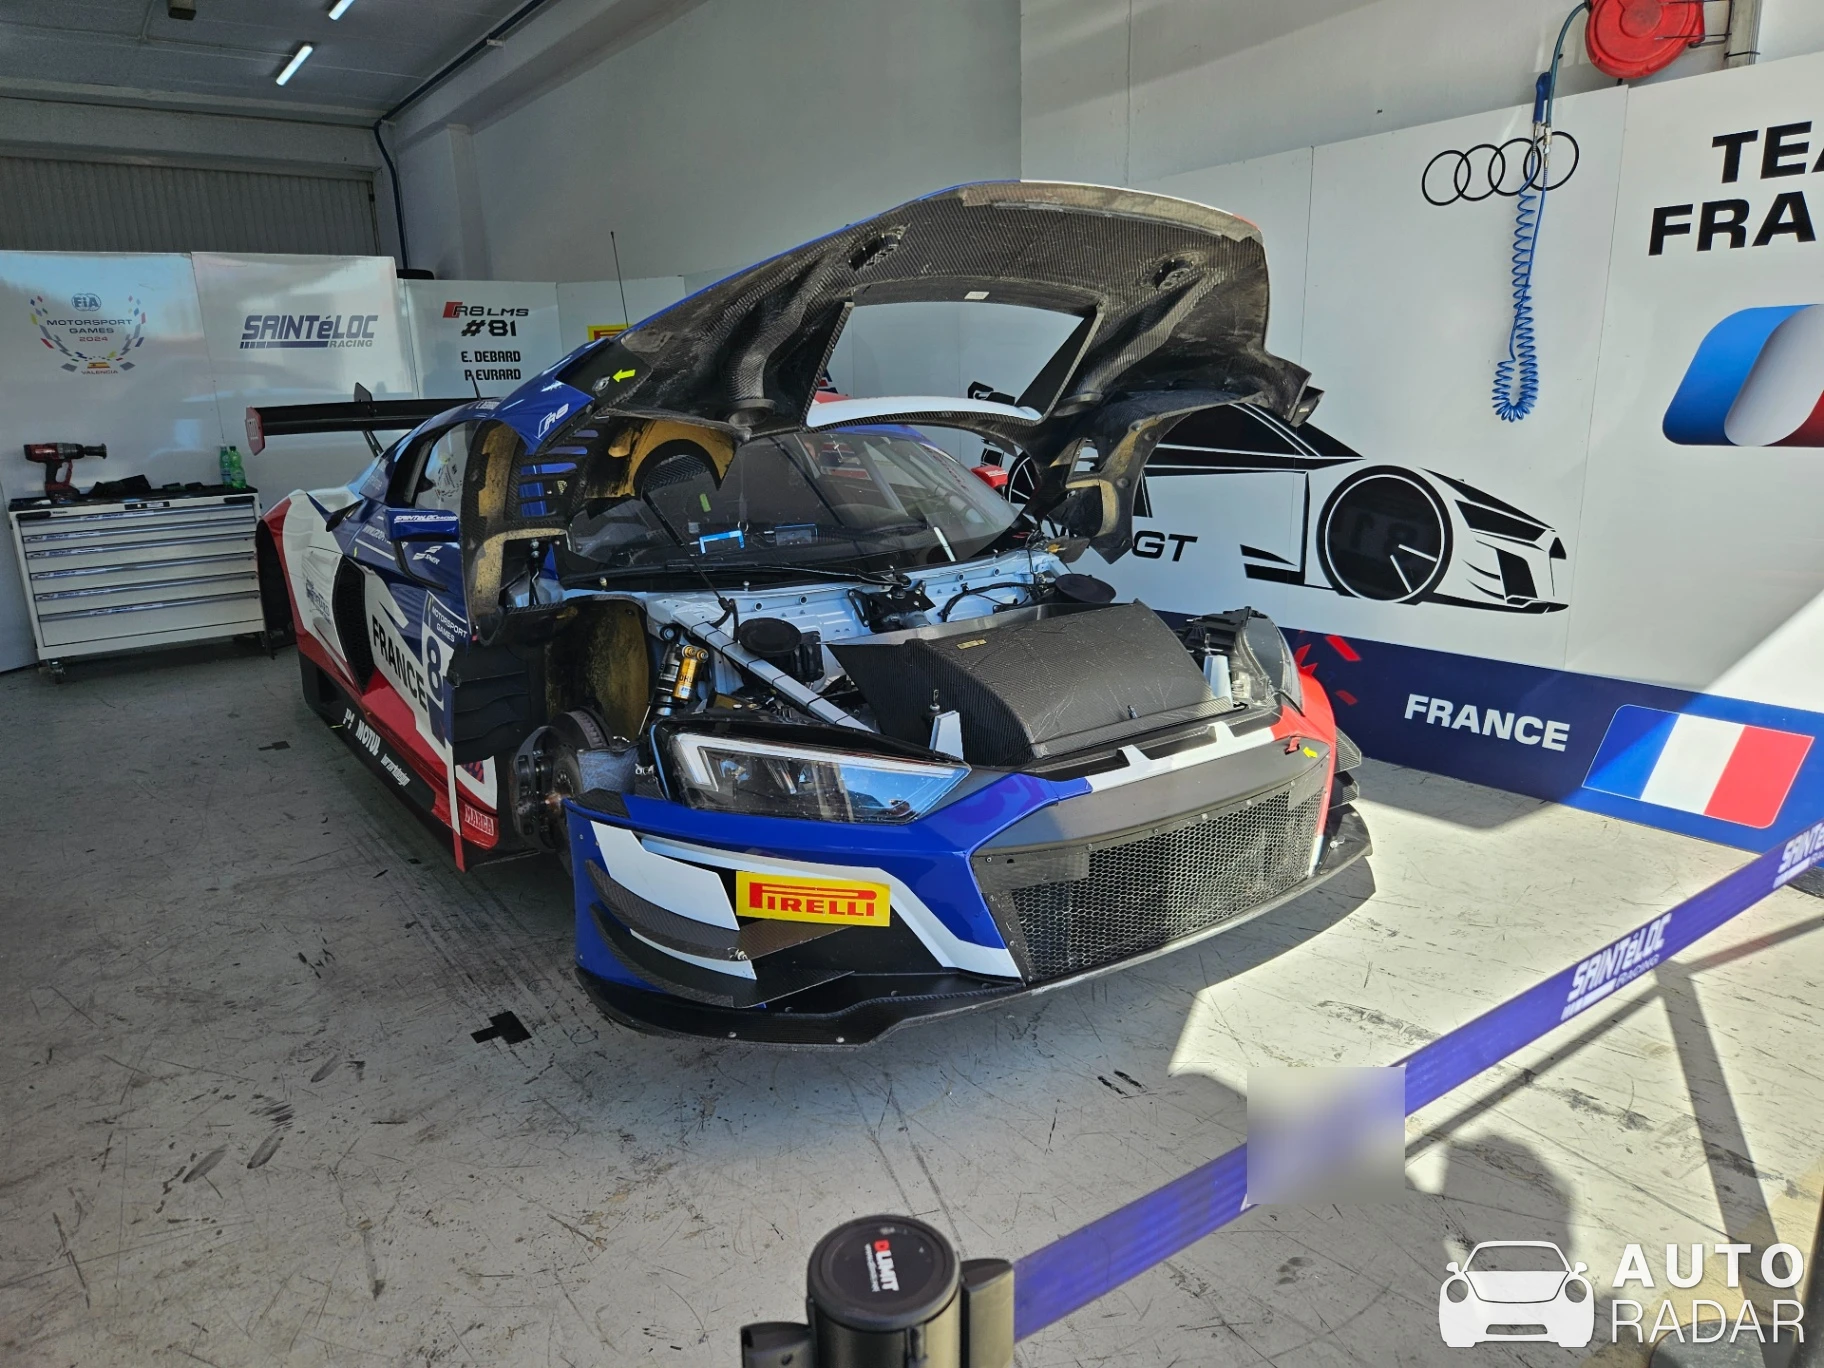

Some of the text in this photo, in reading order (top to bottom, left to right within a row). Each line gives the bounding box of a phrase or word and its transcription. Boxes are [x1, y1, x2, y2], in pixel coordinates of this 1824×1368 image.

[1711, 121, 1824, 184] TE
[1648, 190, 1817, 256] FRA
[453, 305, 530, 317] R8 LMS
[329, 339, 373, 348] RACING
[461, 319, 517, 337] #81
[461, 350, 521, 363] E. DEBARD
[464, 368, 521, 381] P EVRARD
[432, 606, 468, 638] MOTORSPORT
[436, 622, 455, 643] GAMES
[372, 614, 428, 713] FRANCE
[356, 719, 381, 757] MOTUL
[1404, 693, 1571, 752] FRANCE
[465, 804, 494, 836] MARCA
[749, 882, 877, 917] PIRELLI
[1615, 954, 1660, 988] RACING
